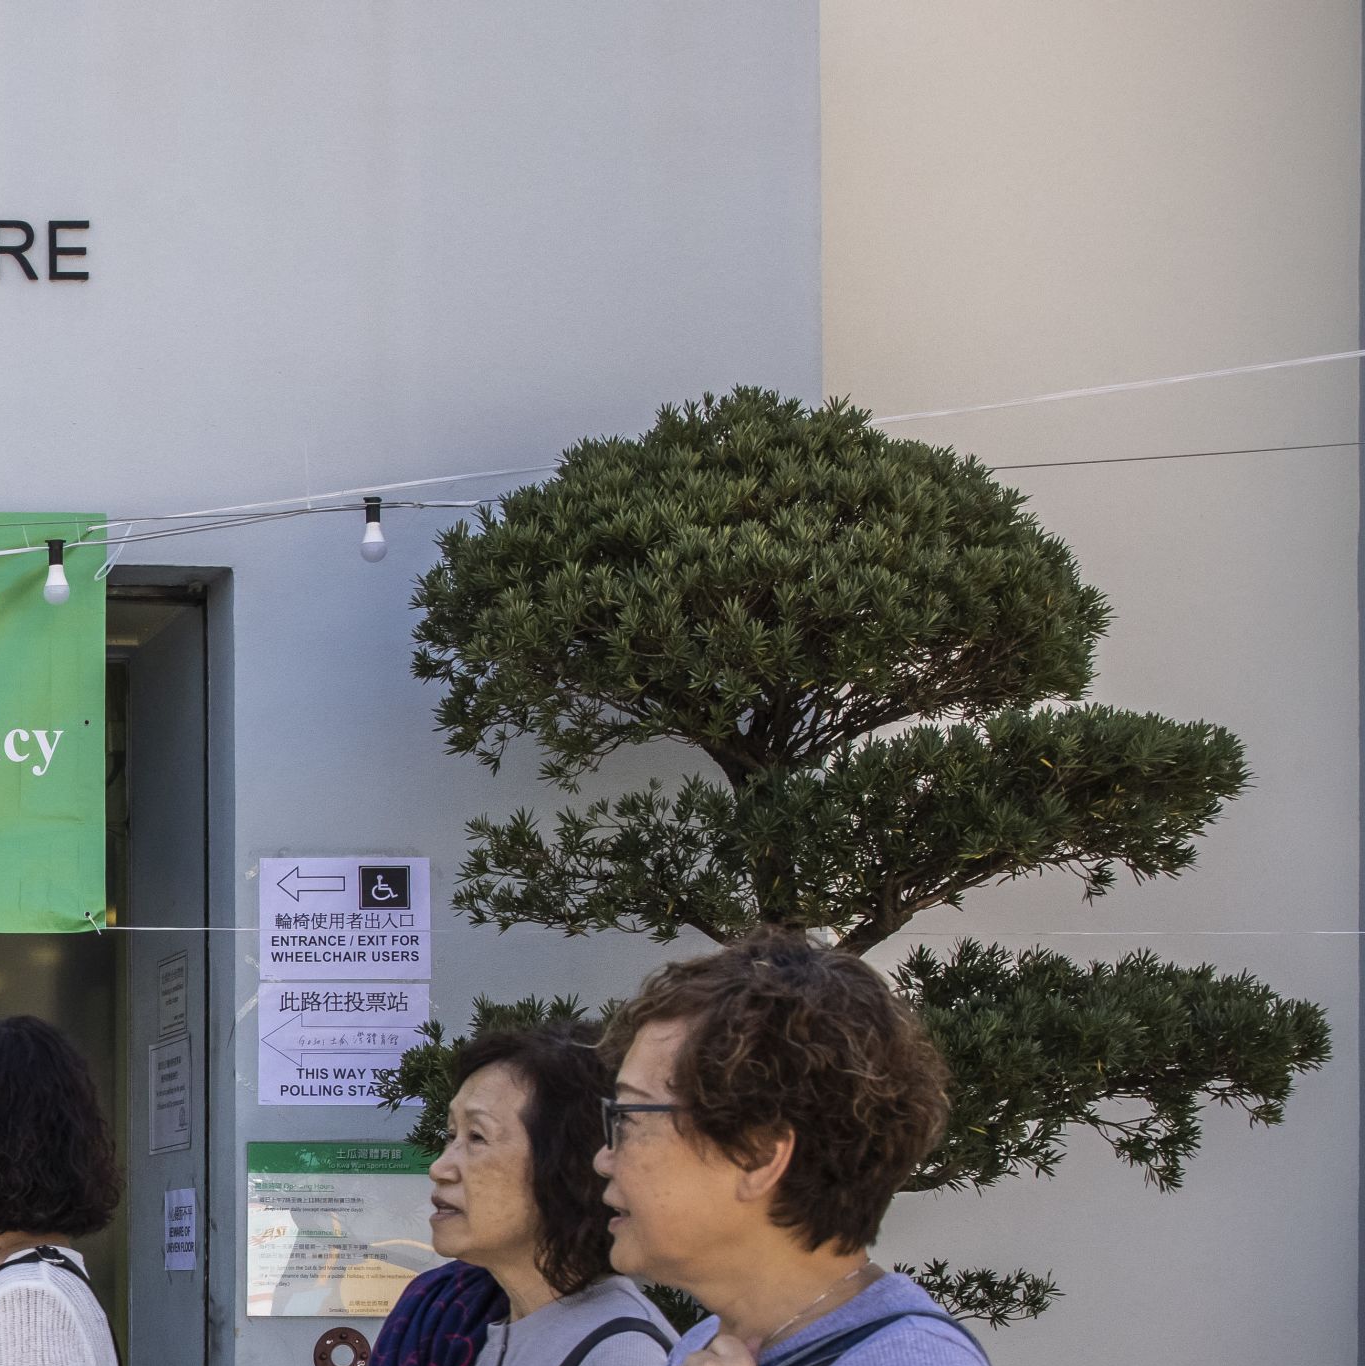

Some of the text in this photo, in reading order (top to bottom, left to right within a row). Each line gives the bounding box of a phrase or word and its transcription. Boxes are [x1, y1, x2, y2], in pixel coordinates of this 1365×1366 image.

[275, 913, 414, 930] 輪椅使用者出入口
[271, 935, 346, 947] ENTRANCE
[357, 935, 386, 946] EXIT
[391, 935, 419, 946] FOR
[271, 951, 419, 963] WHEELCHAIR USERS
[279, 991, 408, 1013] 此路往投票站
[296, 1068, 329, 1080] THIS
[333, 1068, 366, 1080] WAY
[280, 1084, 344, 1097] POLLING
